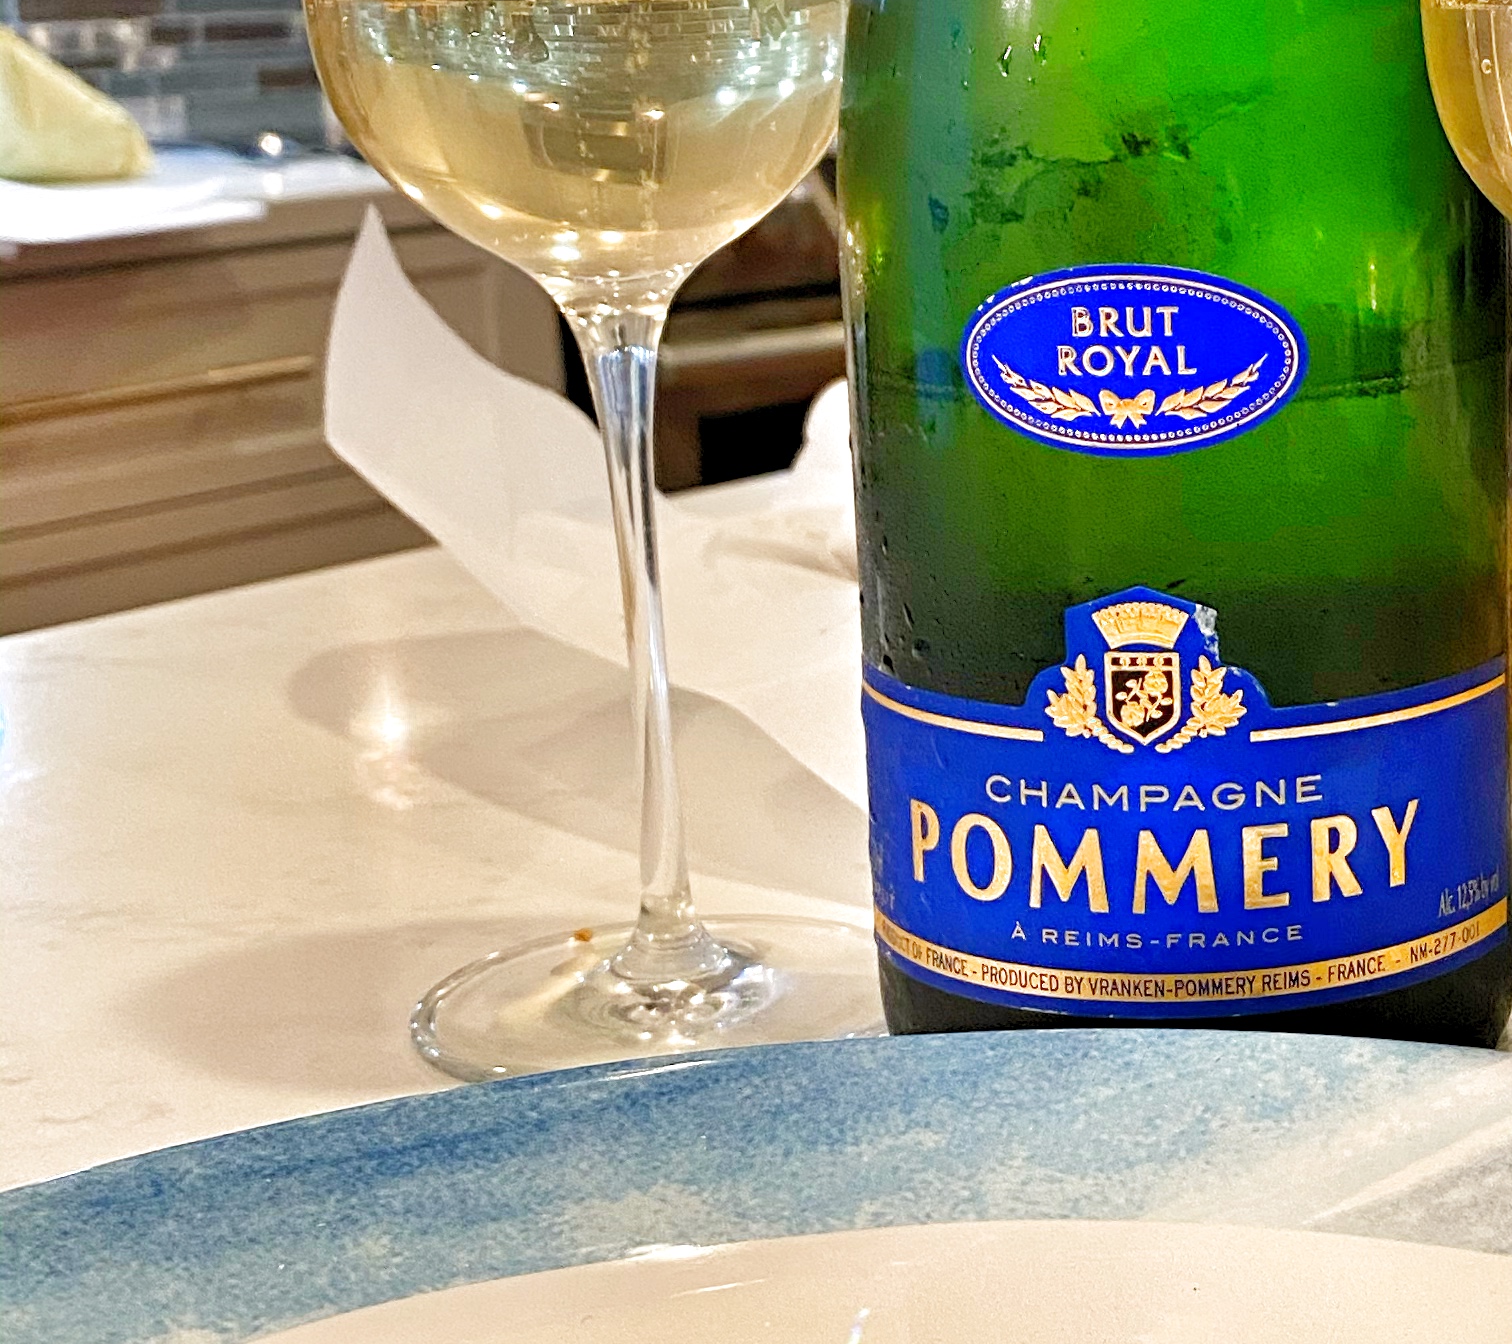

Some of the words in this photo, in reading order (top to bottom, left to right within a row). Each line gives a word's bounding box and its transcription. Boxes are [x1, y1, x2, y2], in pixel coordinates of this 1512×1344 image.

[1070, 305, 1179, 338] BRUT
[1056, 344, 1198, 377] ROYAL
[985, 773, 1325, 813] CHAMPAGNE
[909, 797, 1419, 915] POMMERY
[1010, 920, 1027, 941] À
[1041, 924, 1304, 949] REIMS-FRANCE
[925, 946, 969, 977] FRANCE
[981, 963, 1059, 992] PRODUCED
[1064, 976, 1084, 995] BY
[1088, 974, 1256, 998] VRANKEN-POMMERY
[1261, 969, 1311, 992] REIMS
[1327, 954, 1386, 984] FRANCE
[1409, 920, 1481, 964] NM-277-001
